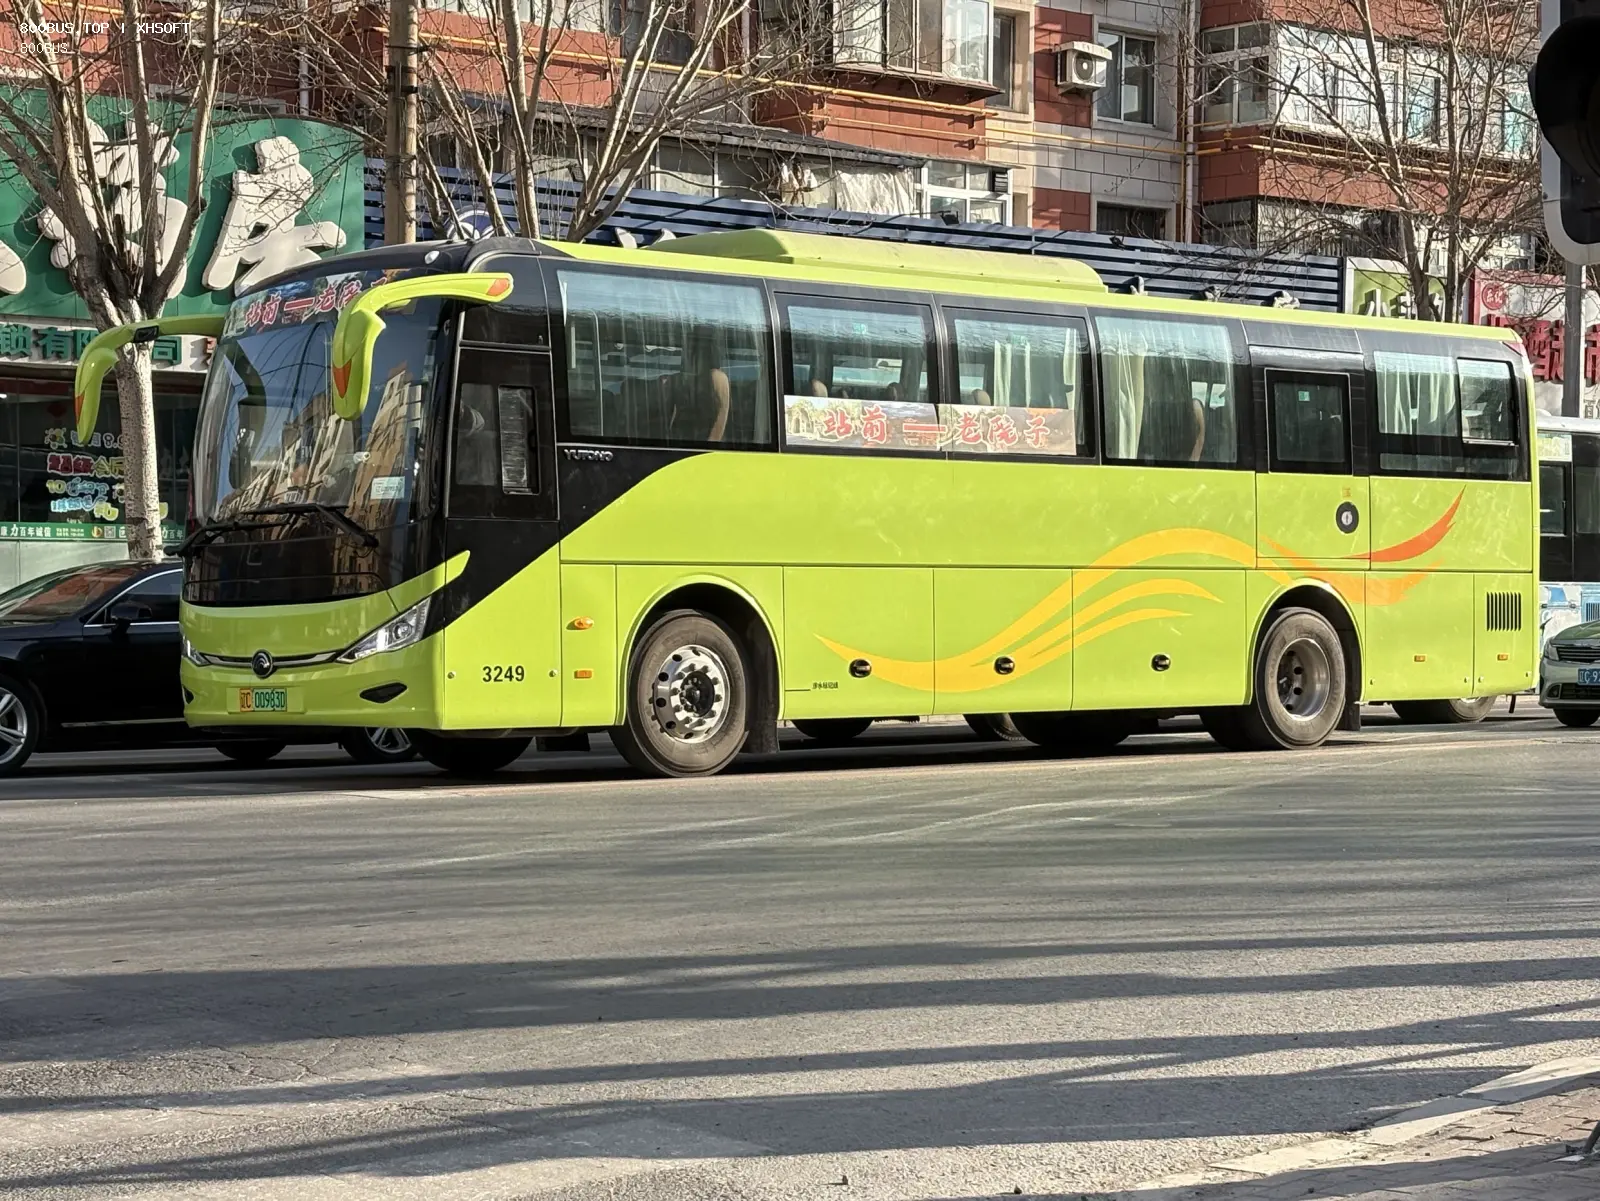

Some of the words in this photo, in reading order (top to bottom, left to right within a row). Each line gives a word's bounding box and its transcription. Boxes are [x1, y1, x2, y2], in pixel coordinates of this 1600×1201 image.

[0, 323, 182, 367] 锁有司
[482, 664, 525, 683] 3249
